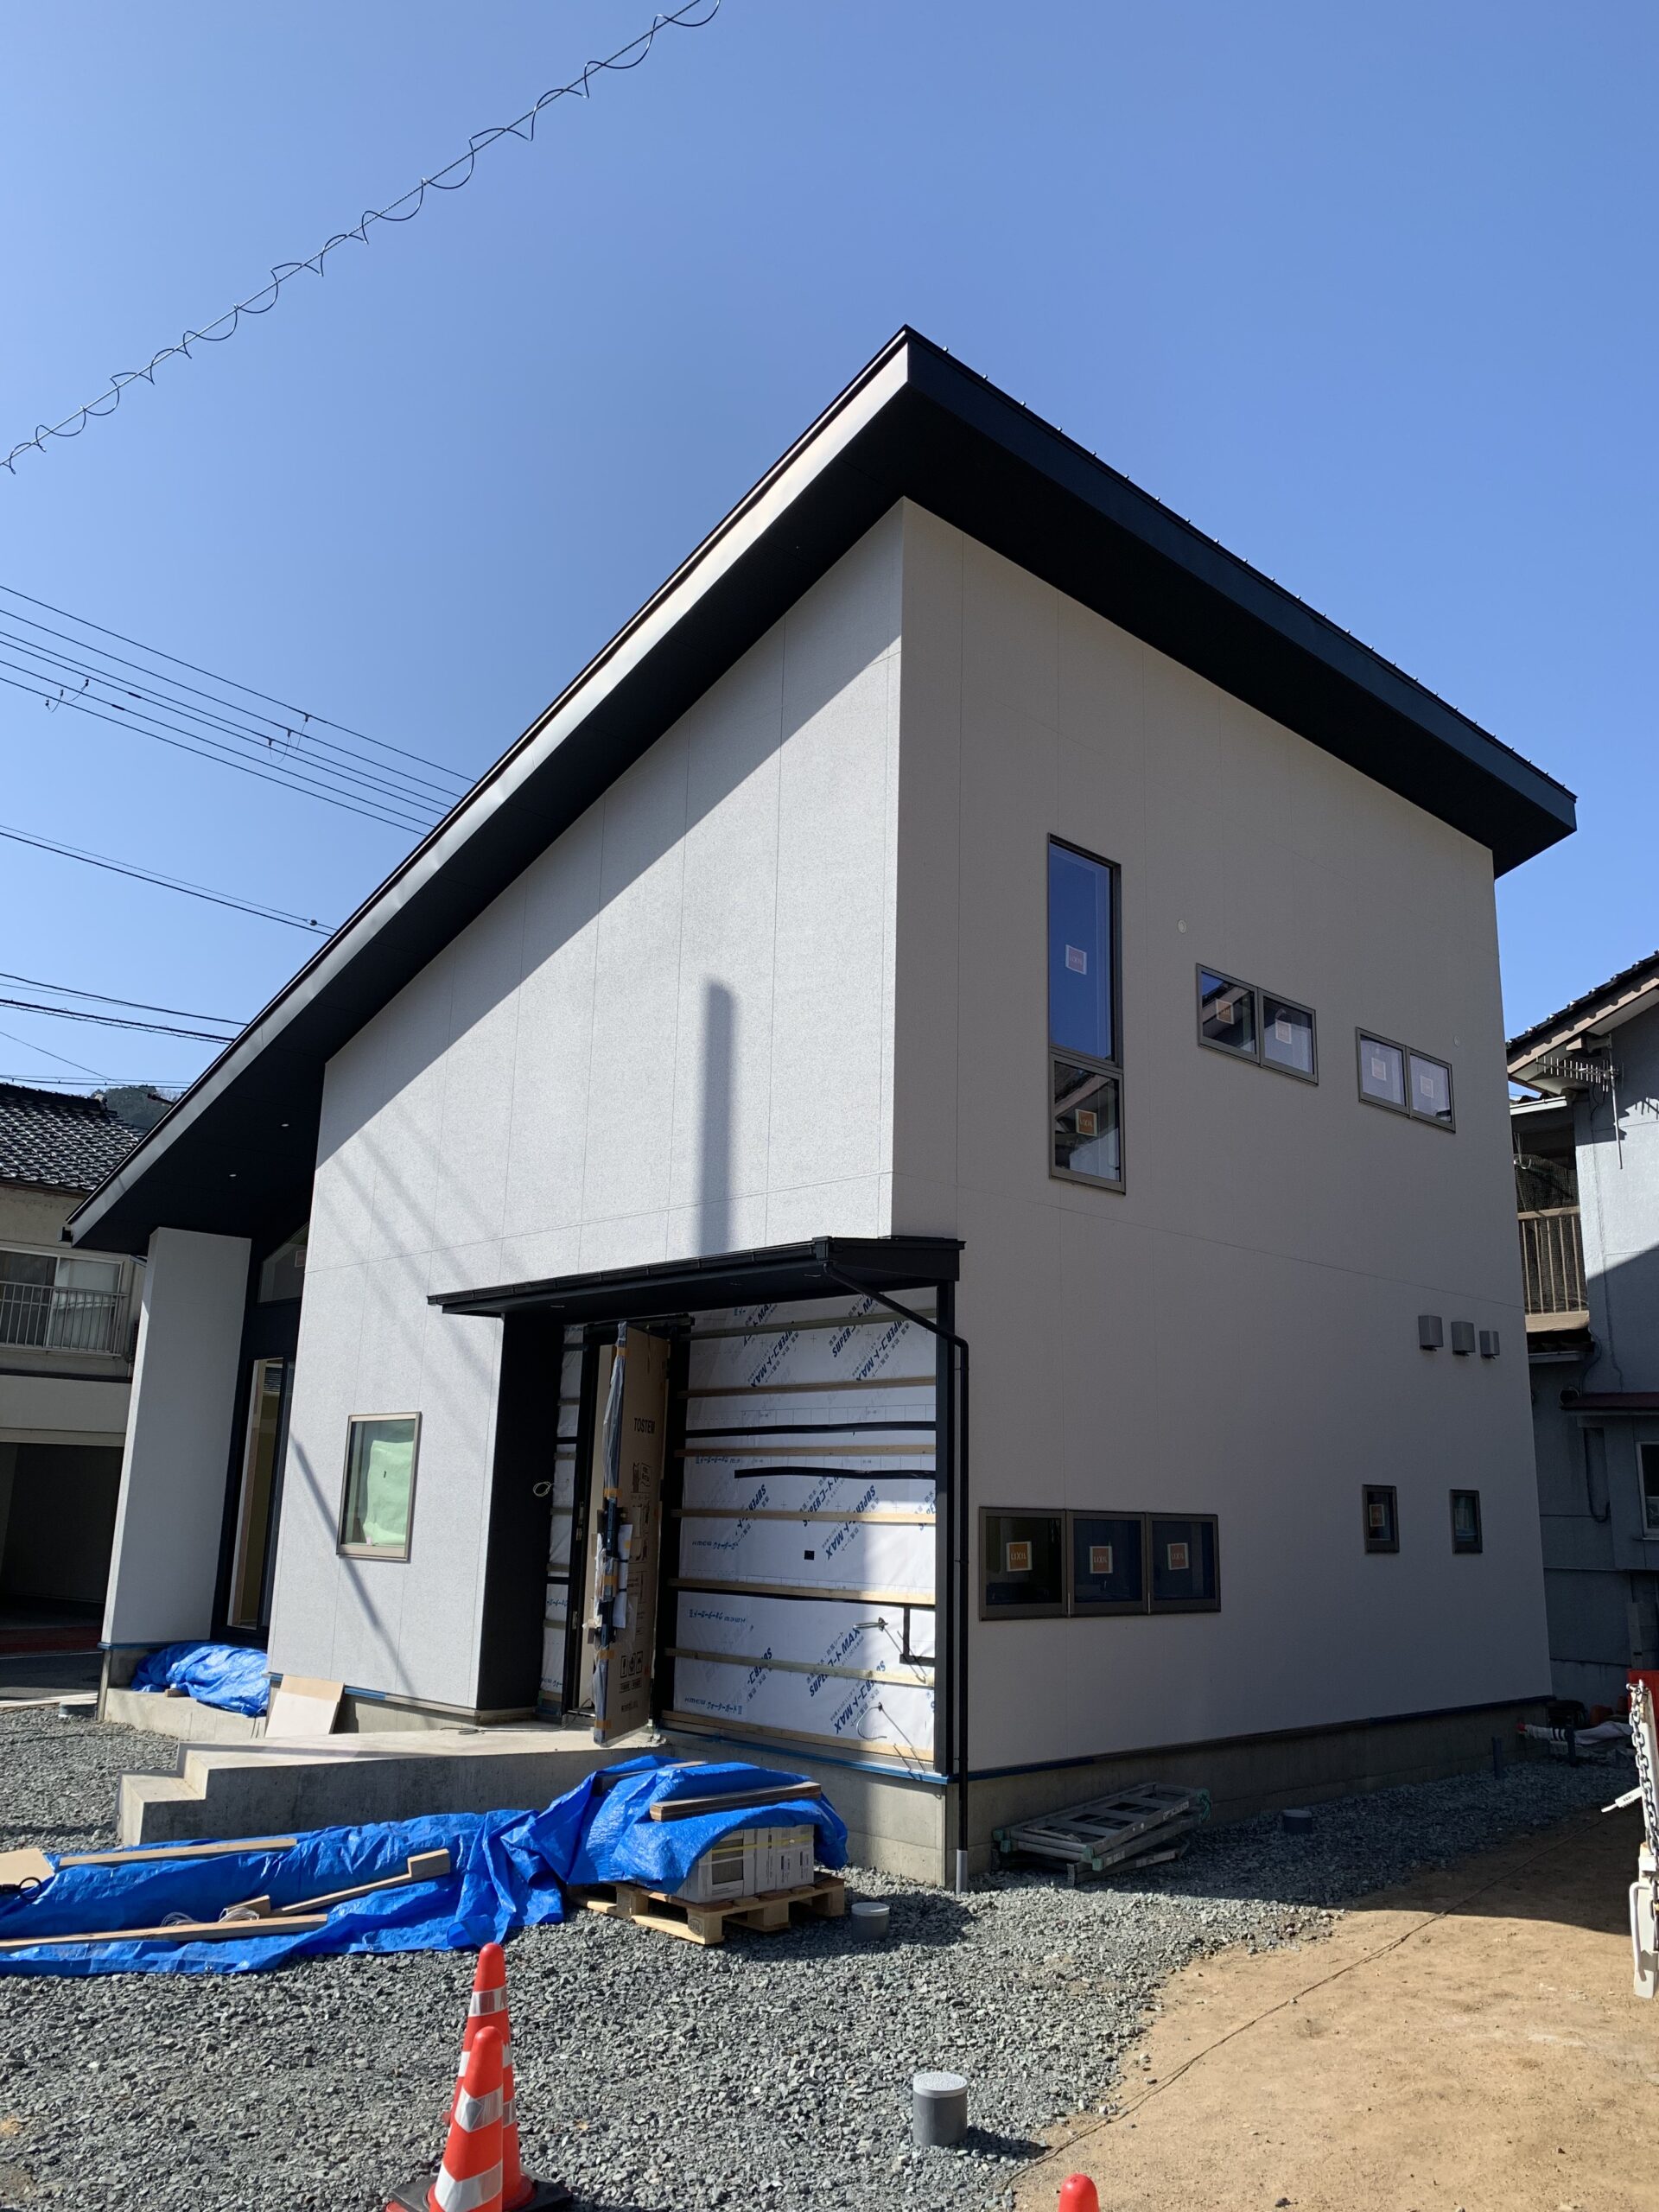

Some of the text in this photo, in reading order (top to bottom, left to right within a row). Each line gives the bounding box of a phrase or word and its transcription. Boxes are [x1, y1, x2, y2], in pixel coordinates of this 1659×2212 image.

[633, 1418, 655, 1434] TOSTEM
[825, 1529, 844, 1560] MAX
[1011, 1552, 1027, 1560] LIXIL
[841, 1628, 861, 1654] MAX
[834, 1705, 854, 1735] MAX
